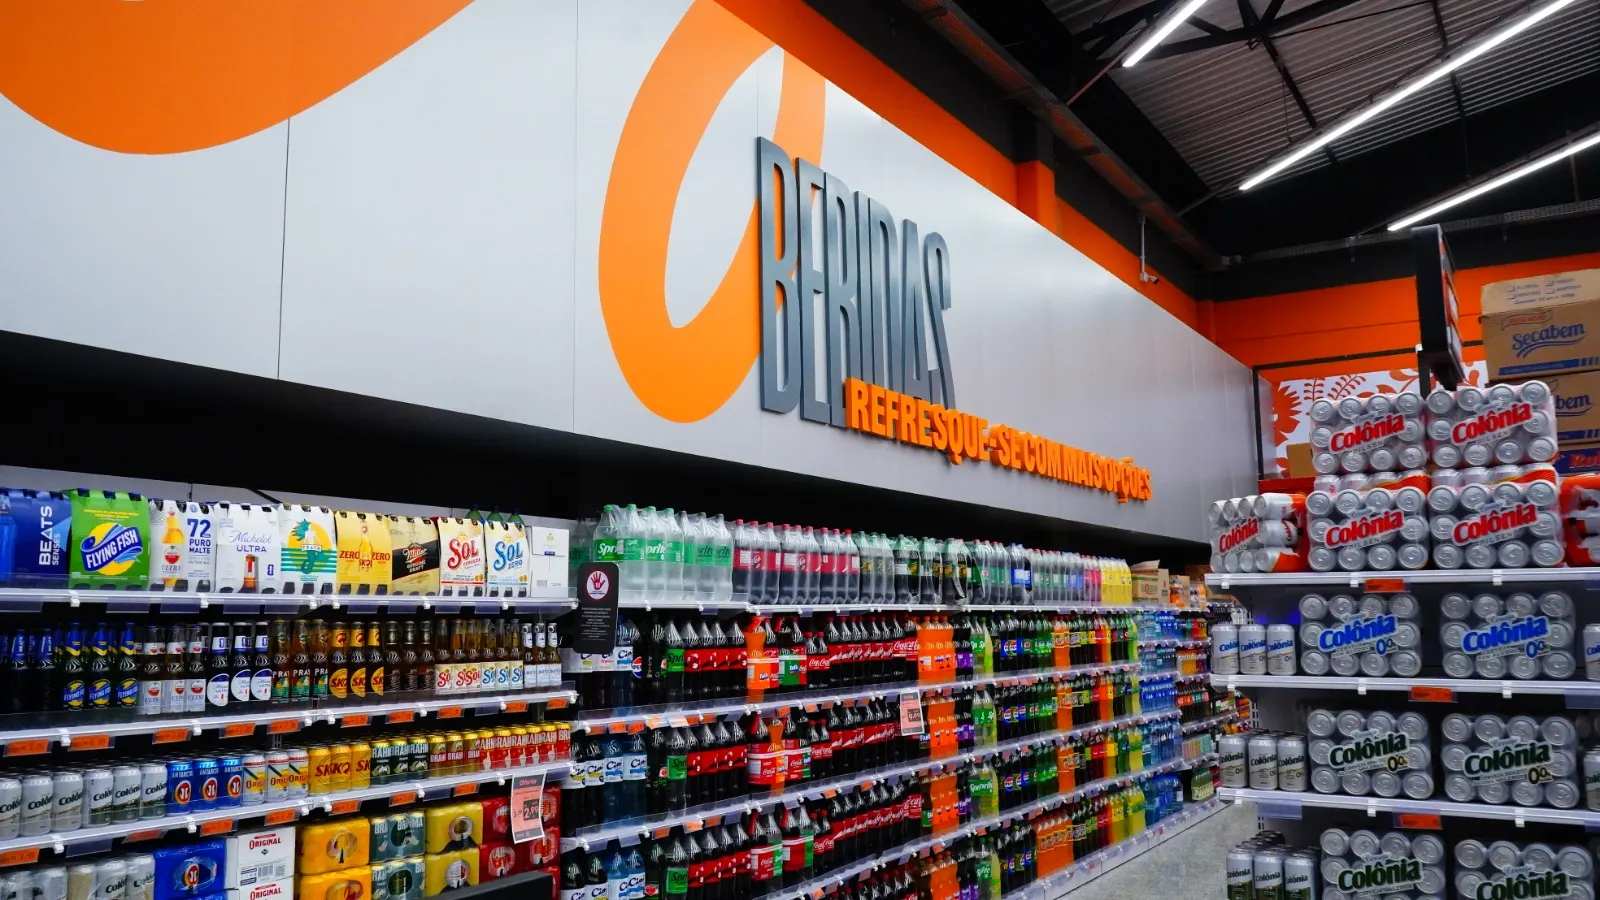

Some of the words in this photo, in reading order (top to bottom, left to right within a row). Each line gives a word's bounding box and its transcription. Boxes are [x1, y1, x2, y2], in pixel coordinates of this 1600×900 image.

[757, 136, 956, 427] BEBIDAS
[1511, 323, 1586, 350] Secabem
[845, 377, 1021, 466] REFRESQUE-SE
[1021, 431, 1061, 480] COM
[1061, 444, 1102, 490] MAIS
[1102, 456, 1153, 503] OPÇÕES
[1329, 414, 1405, 453] Colônia
[1452, 403, 1533, 445] Colônia
[39, 505, 53, 566] BEATS
[187, 518, 211, 538] 72
[1218, 517, 1259, 554] Colônia
[1326, 510, 1404, 547] Colônia
[1453, 504, 1537, 545] Colônia
[52, 533, 61, 566] SENSES
[85, 542, 118, 568] FLYING
[117, 529, 139, 551] FISH
[189, 538, 211, 547] PURO
[236, 545, 267, 553] ULTRA
[339, 550, 360, 560] ZERO
[372, 552, 390, 560] ZERO
[402, 548, 427, 562] Miller
[507, 559, 523, 569] ZERO
[1319, 615, 1396, 649] Colônia
[1462, 616, 1548, 652] Colônia
[1330, 734, 1406, 767] Colônia
[1465, 743, 1550, 774] Colônia
[249, 838, 281, 851] ORIGINAL
[1255, 870, 1281, 882] Colônia
[1338, 859, 1421, 891] Colônia
[1476, 871, 1569, 900] Colônia
[250, 887, 282, 900] ORIGINAL
